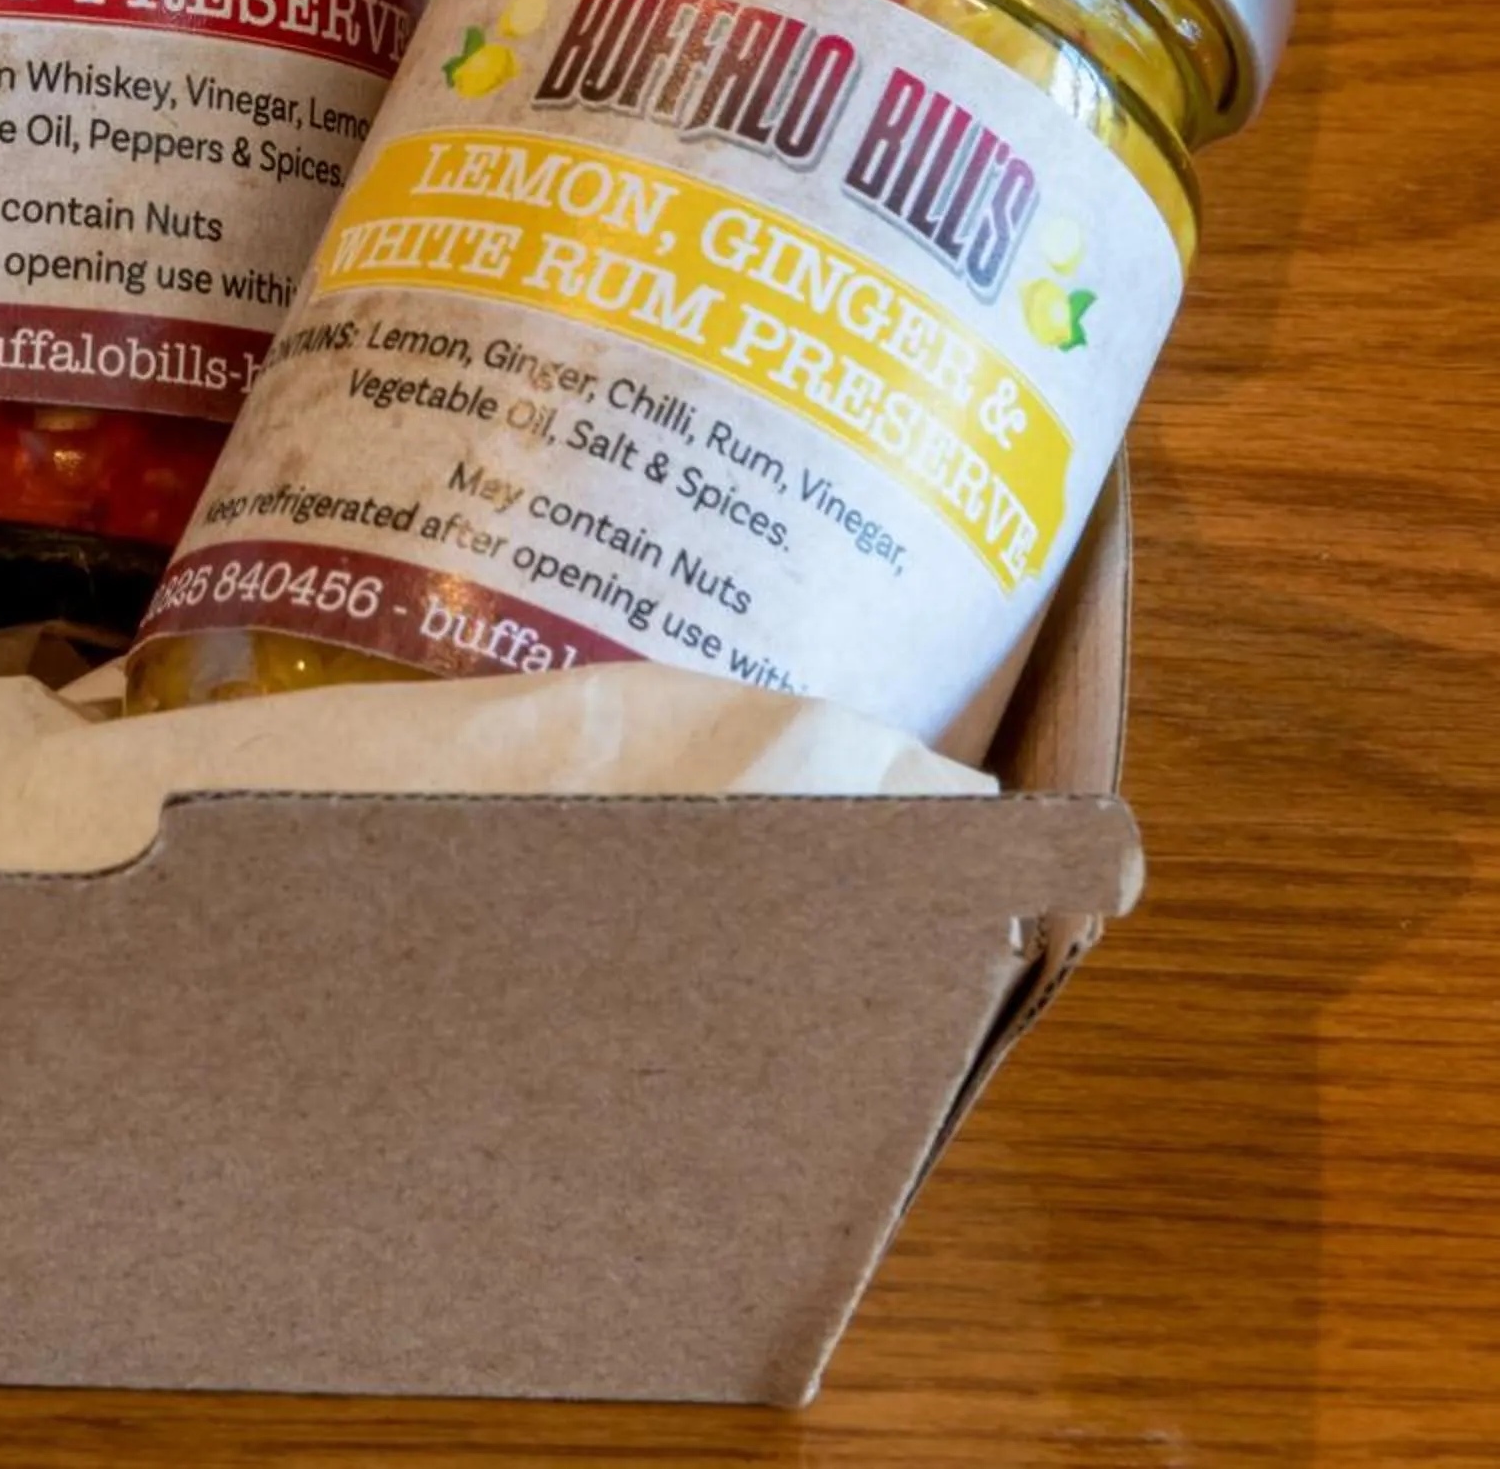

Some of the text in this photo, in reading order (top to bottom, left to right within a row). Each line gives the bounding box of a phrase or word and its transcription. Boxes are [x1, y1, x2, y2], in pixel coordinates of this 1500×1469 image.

[27, 61, 178, 111] Whiskey,
[186, 76, 303, 129] Vinegar,
[27, 116, 81, 155] Oil,
[89, 119, 224, 165] Peppers
[231, 137, 251, 169] &
[259, 143, 345, 188] Spices.
[1, 196, 135, 231] contain
[145, 203, 223, 242] Nuts
[843, 67, 1038, 303] BILL'S
[5, 250, 146, 296] opening
[157, 262, 213, 296] use
[220, 271, 298, 308] withi
[410, 142, 1028, 451] LEMON, GINGER &
[331, 216, 1039, 579] WHITE RUM PRESERVE
[348, 368, 792, 553] Vegetable Oil, Salt & Spices.
[366, 321, 472, 367] Lemon,
[483, 337, 599, 403] Ginger,
[607, 378, 696, 445] Chilli,
[706, 421, 788, 489] Rum,
[798, 468, 907, 576] Vinegar,
[213, 560, 383, 619] 840456
[250, 484, 419, 531] refrigerated
[420, 507, 506, 558] after
[512, 542, 657, 630] opening
[663, 610, 722, 659] use
[449, 462, 753, 615] May contain Nuts
